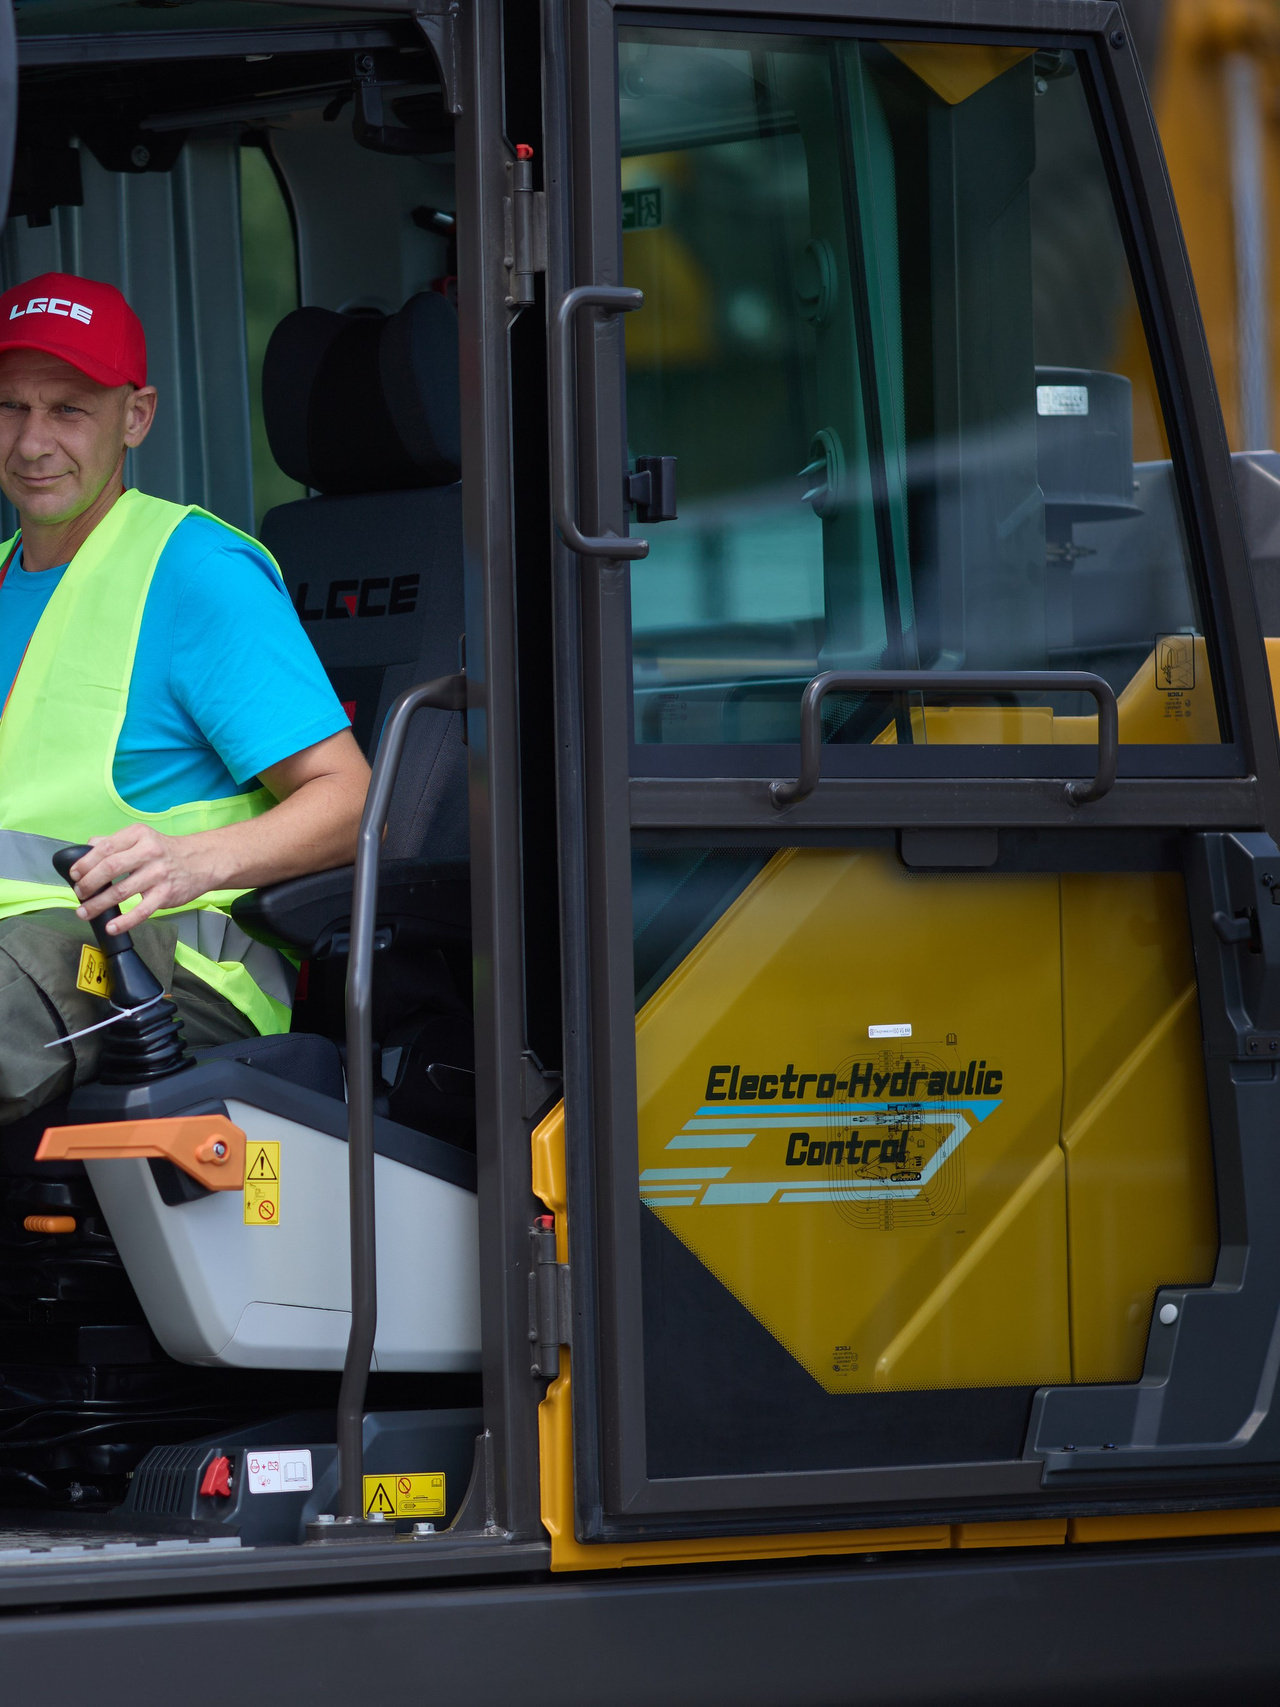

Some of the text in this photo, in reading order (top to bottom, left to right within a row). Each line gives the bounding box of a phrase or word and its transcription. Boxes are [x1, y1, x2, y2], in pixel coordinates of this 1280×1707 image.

[9, 297, 94, 325] LGCE
[295, 573, 420, 621] LGCE
[705, 1060, 1004, 1101] Electro-Hydraulic
[785, 1130, 910, 1166] Control
